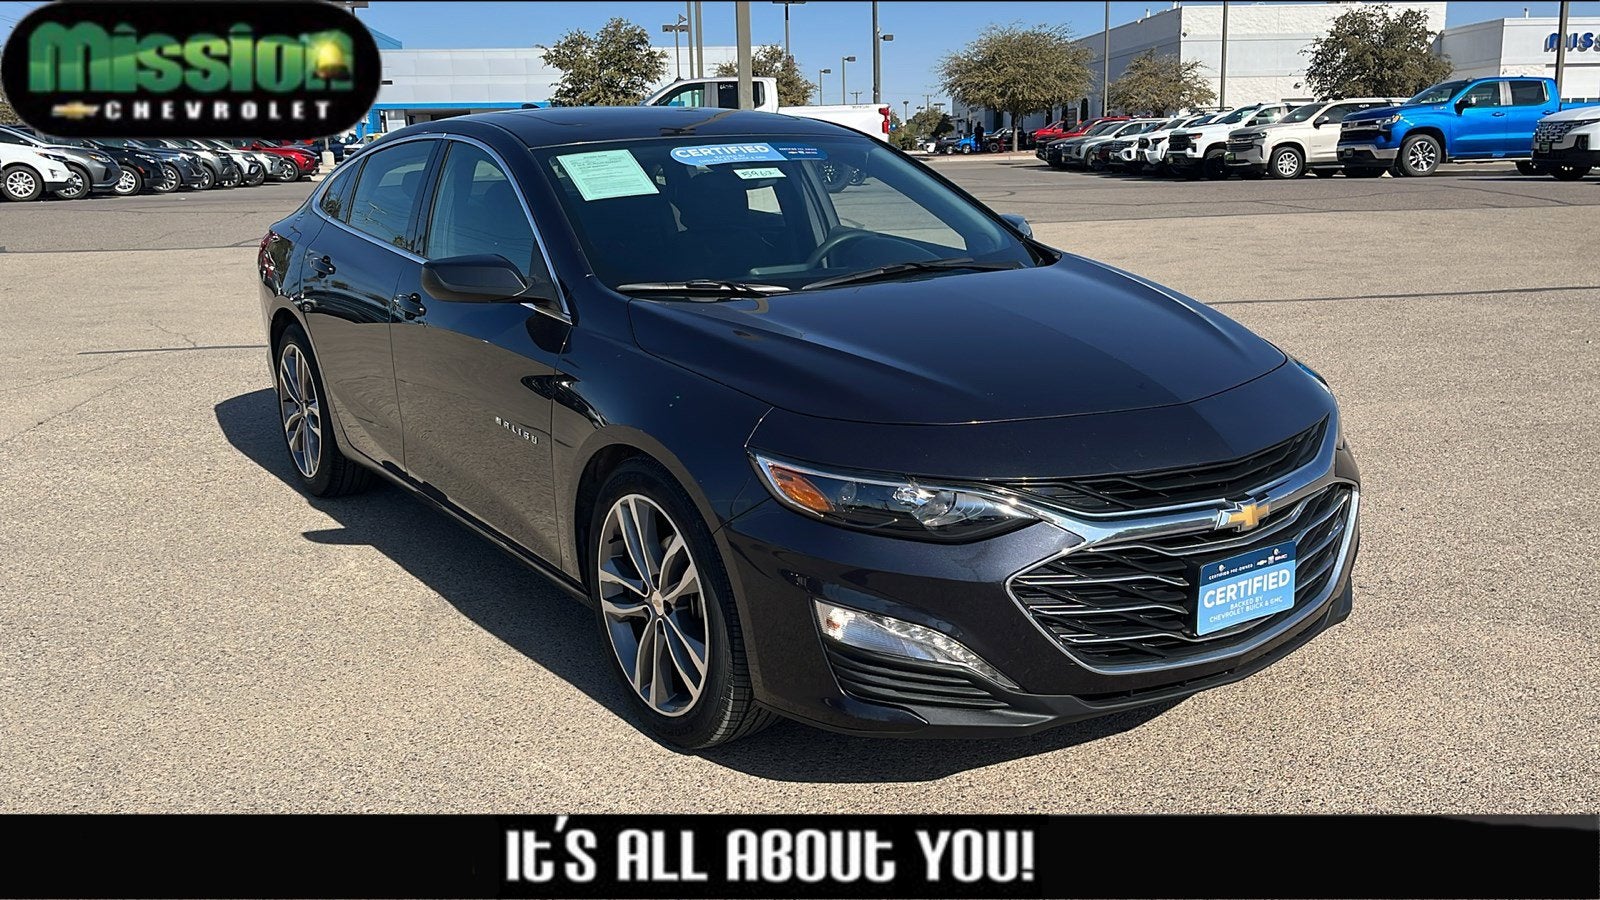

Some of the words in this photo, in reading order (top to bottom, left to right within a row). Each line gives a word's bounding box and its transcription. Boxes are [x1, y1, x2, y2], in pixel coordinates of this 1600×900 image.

[675, 145, 769, 158] CERTIFIED
[495, 416, 538, 445] MALIBU
[1203, 569, 1291, 609] CERTIFIED
[1209, 607, 1244, 623] CHEVROLET
[1245, 601, 1264, 612] BUICK
[1230, 597, 1254, 610] BACKED
